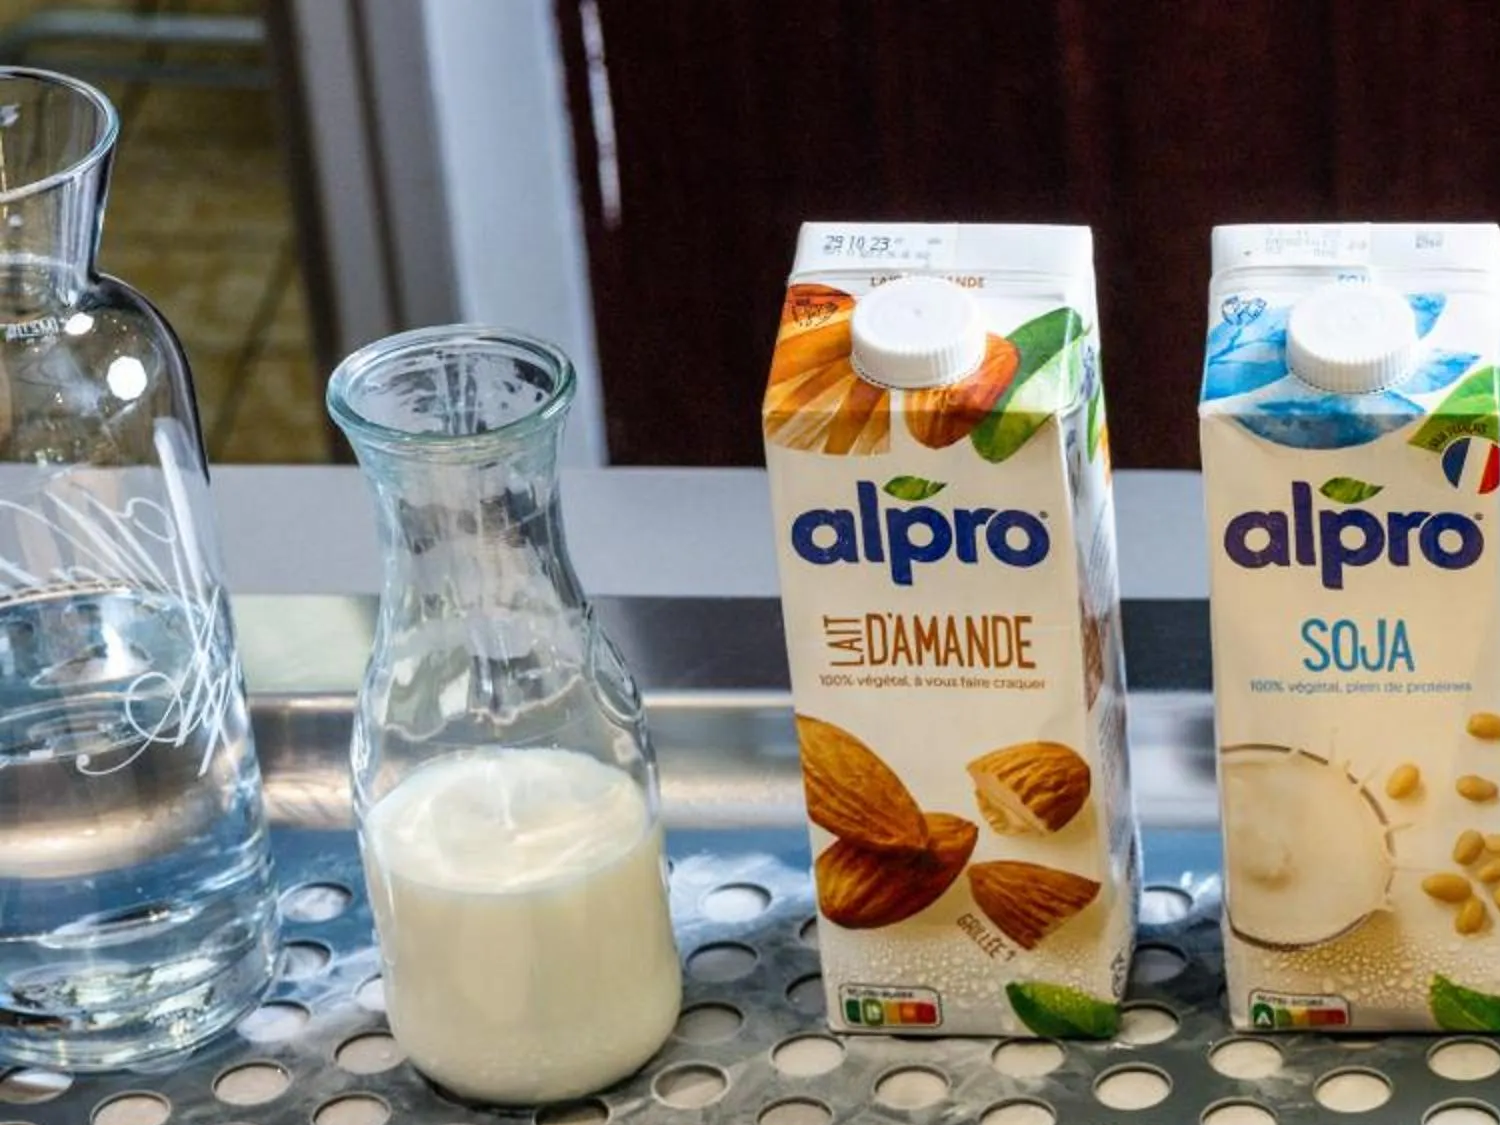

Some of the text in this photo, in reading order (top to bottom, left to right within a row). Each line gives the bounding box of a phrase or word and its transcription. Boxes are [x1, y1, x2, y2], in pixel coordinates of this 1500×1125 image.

[791, 480, 1050, 587] alpro
[1224, 481, 1484, 590] alpro
[823, 612, 1037, 670] LAIT D'AMANDE
[1301, 617, 1415, 672] SOJA
[819, 674, 853, 687] 100%
[926, 677, 957, 688] vous
